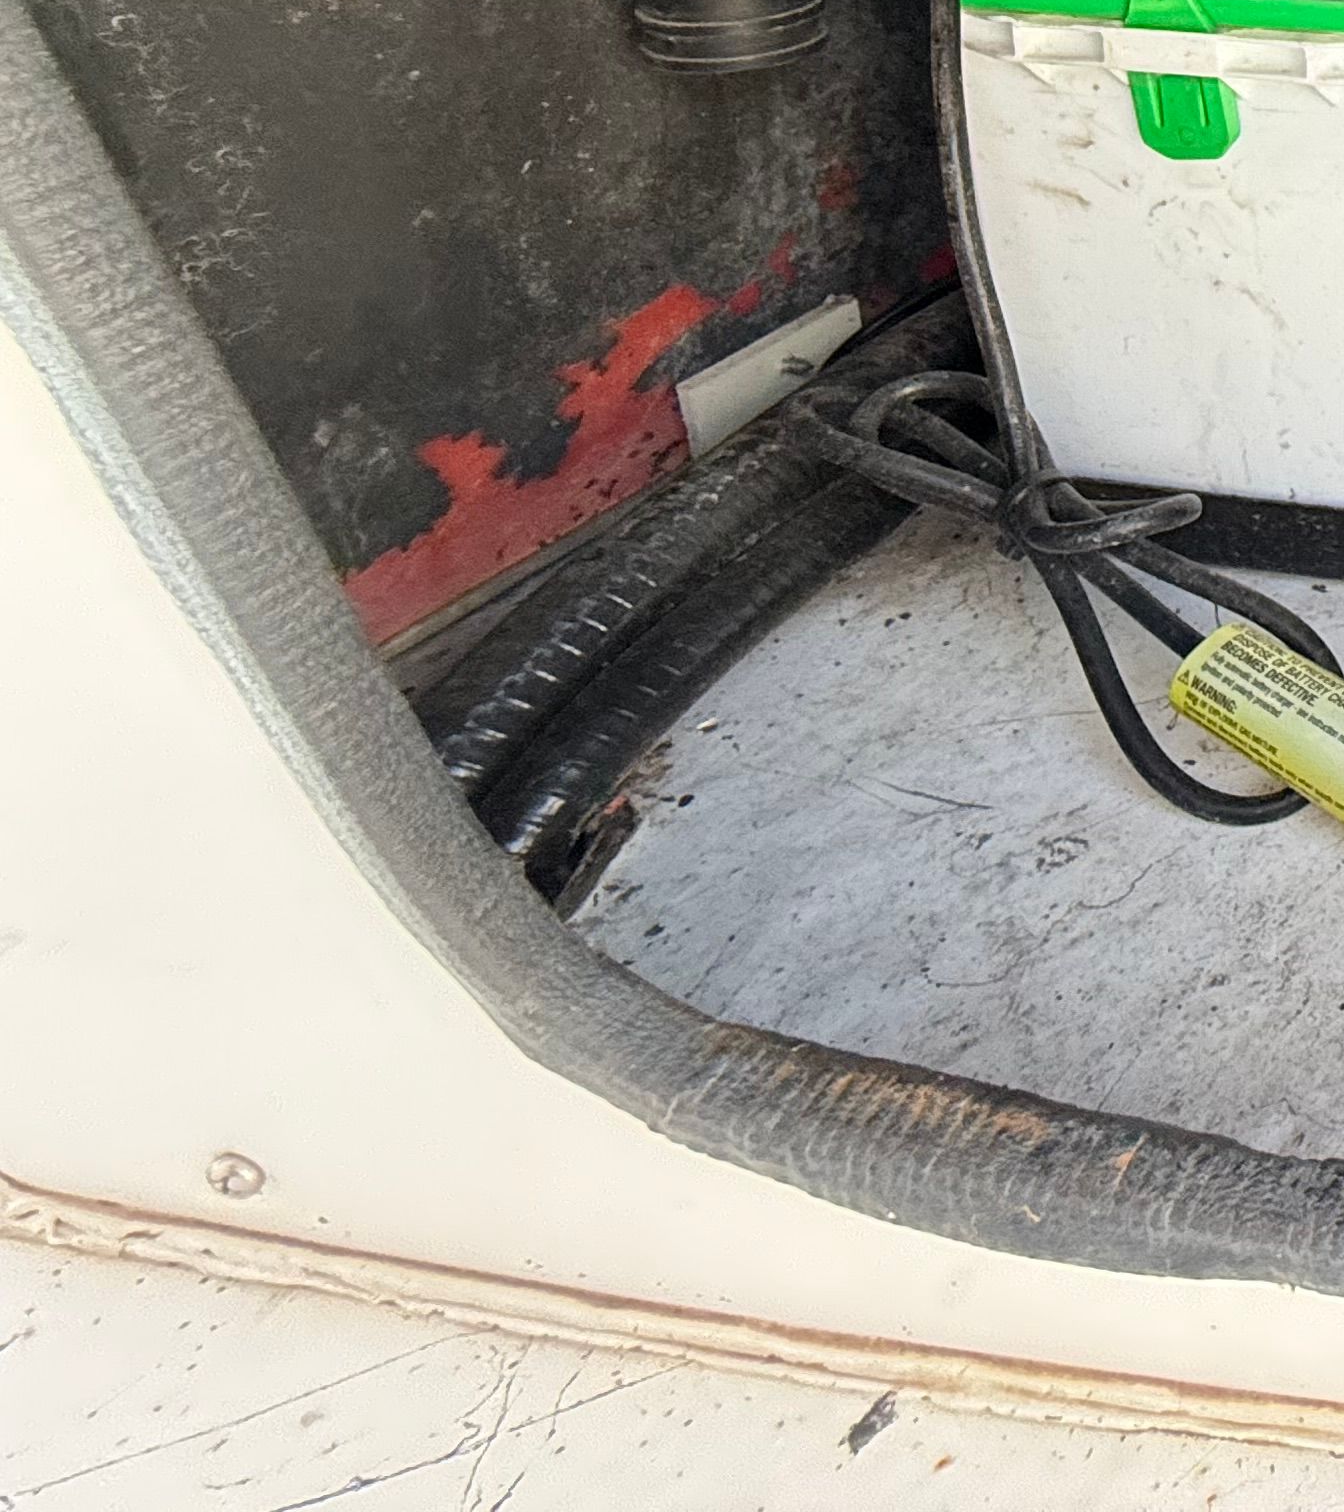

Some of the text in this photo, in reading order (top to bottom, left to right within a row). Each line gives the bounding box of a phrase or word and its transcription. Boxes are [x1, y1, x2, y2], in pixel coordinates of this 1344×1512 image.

[1219, 639, 1268, 673] BECOMES
[1231, 632, 1274, 661] DISPOSE
[1270, 657, 1289, 668] OF
[1284, 665, 1331, 696] BATTERY
[1190, 674, 1237, 714] WARNING:
